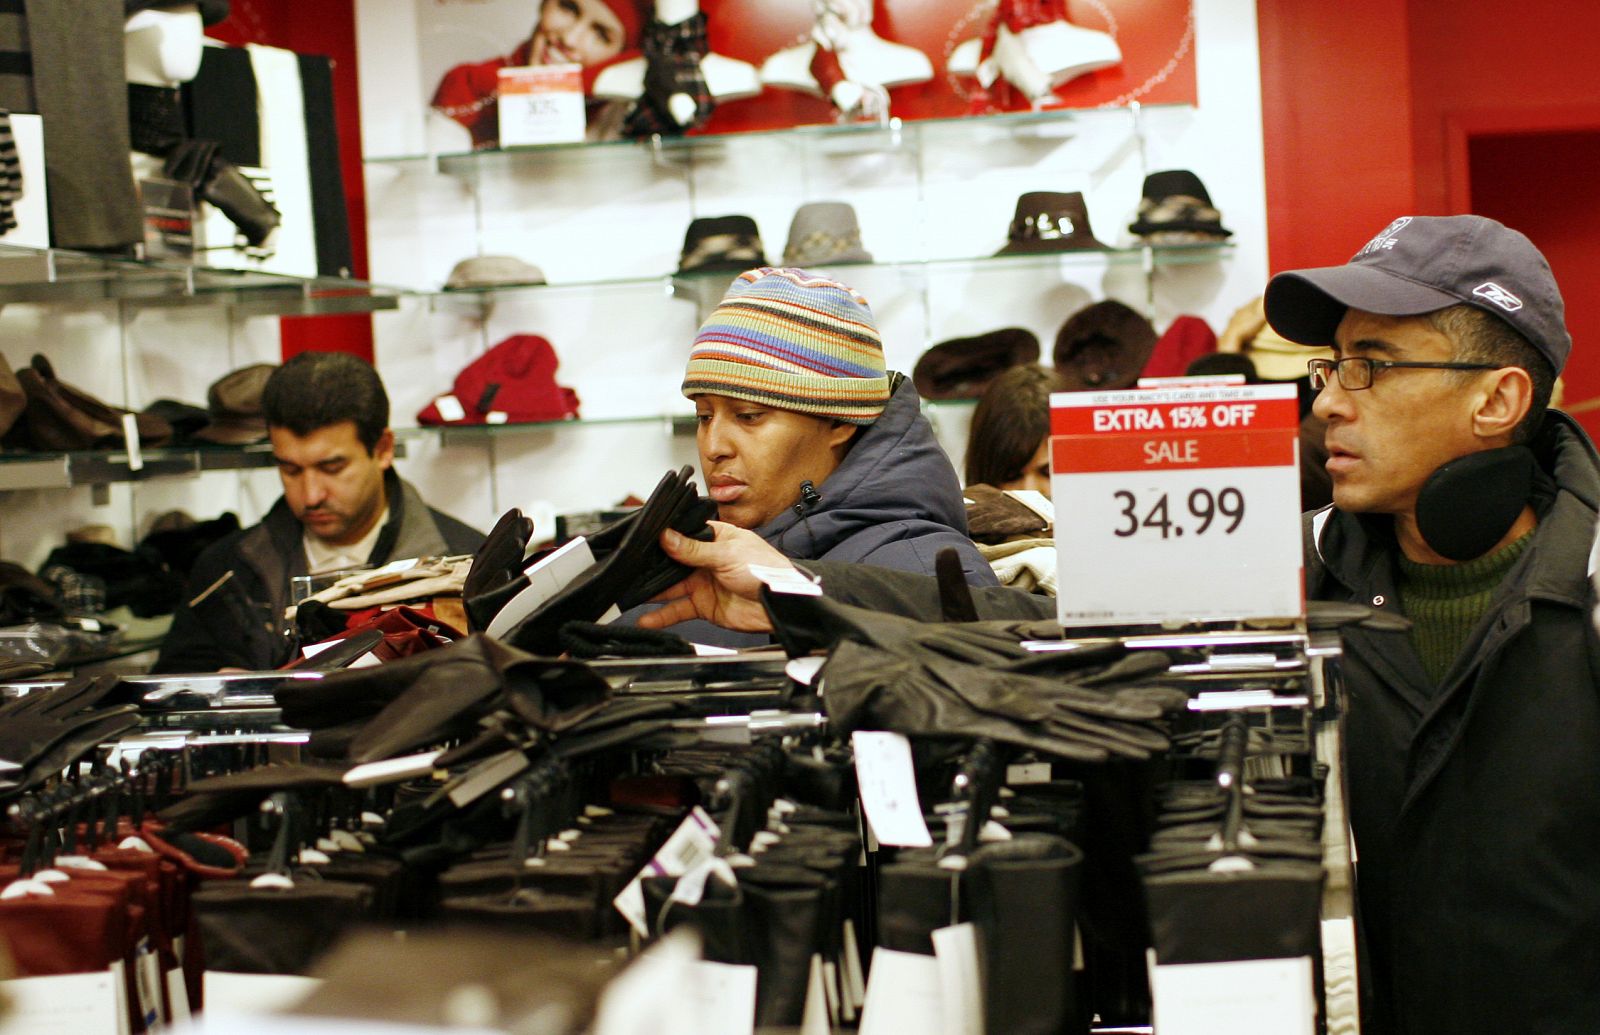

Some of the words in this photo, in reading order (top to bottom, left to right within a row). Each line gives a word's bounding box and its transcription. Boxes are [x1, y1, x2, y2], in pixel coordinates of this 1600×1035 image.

[1093, 407, 1165, 431] EXTRA
[1169, 405, 1207, 429] 15%
[1211, 404, 1257, 427] OFF
[1143, 440, 1199, 464] SALE
[1113, 487, 1245, 539] 34.99
